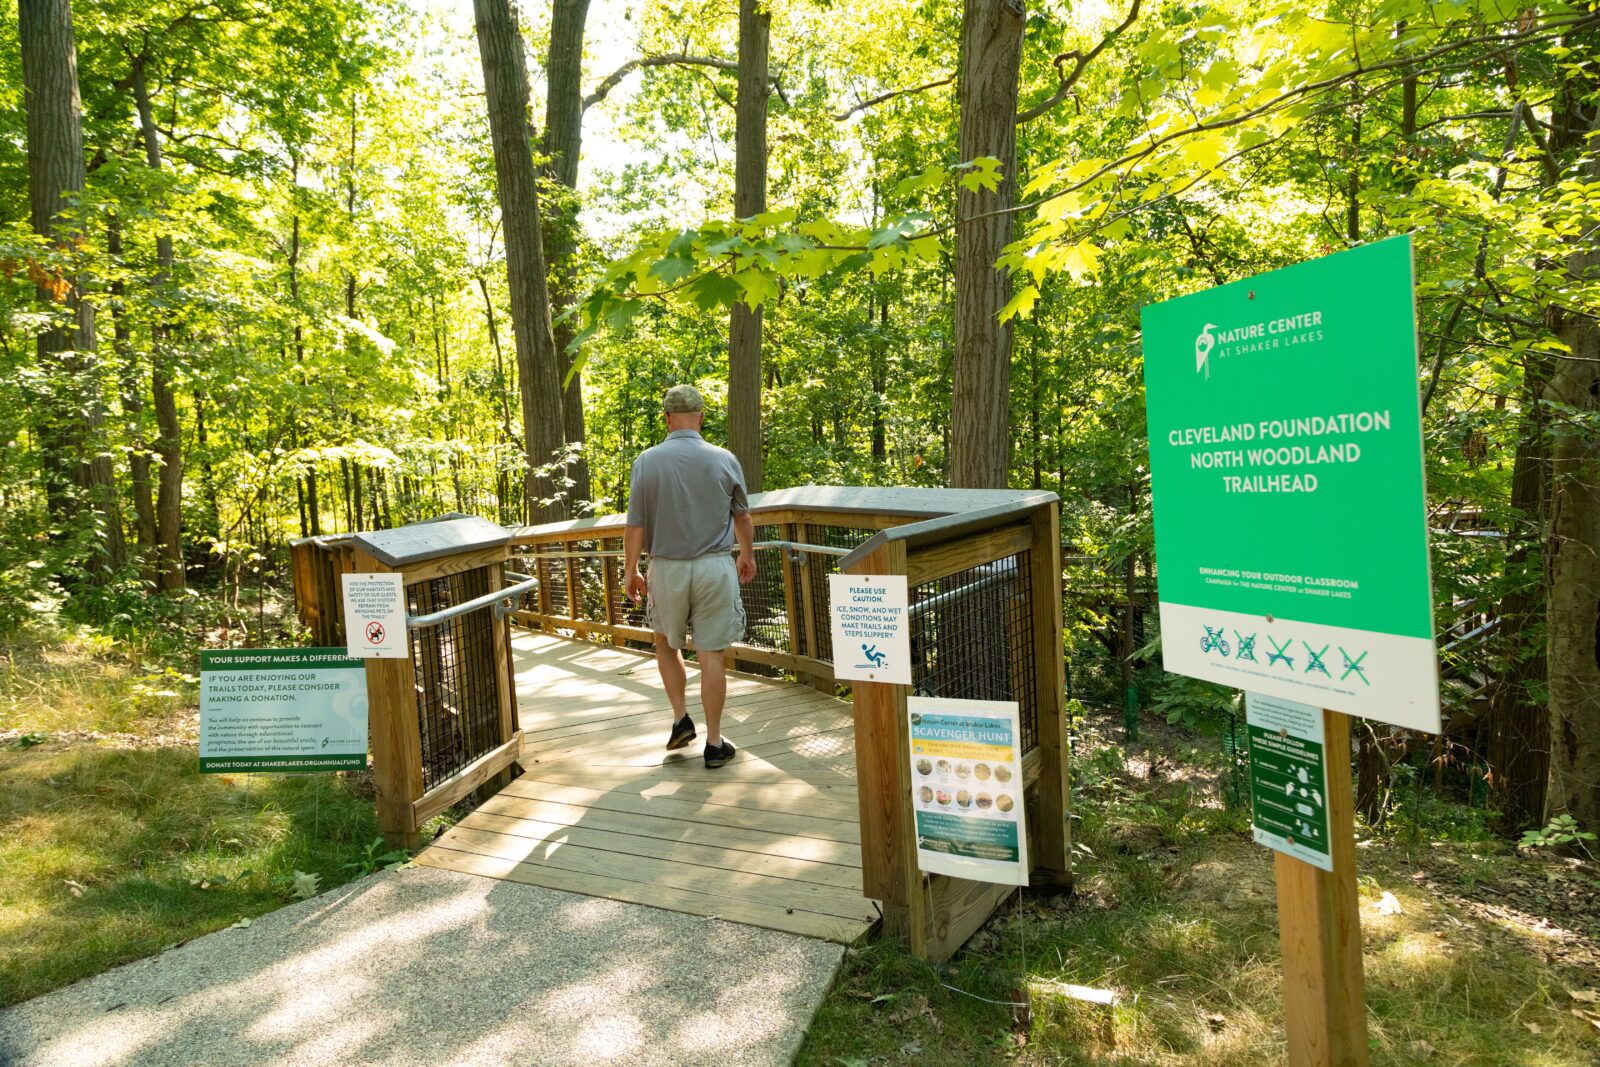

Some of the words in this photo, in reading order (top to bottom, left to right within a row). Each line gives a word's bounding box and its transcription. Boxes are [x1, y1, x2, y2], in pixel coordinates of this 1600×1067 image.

[1218, 323, 1265, 344] NATURE
[1268, 312, 1322, 334] CENTER
[1220, 348, 1230, 358] AT
[1235, 339, 1279, 356] SHAKER
[1285, 330, 1323, 346] LAKES
[1168, 423, 1255, 446] CLEVELAND
[1260, 410, 1390, 439] FOUNDATION
[1191, 450, 1243, 469] NORTH
[1248, 443, 1360, 466] WOODLAND
[1223, 474, 1318, 493] TRAILHEAD
[1200, 567, 1240, 578] ENHANCING
[1241, 571, 1261, 580] YOUR
[1263, 572, 1302, 584] OUTDOOR
[1304, 577, 1358, 589] CLASSROOM
[1274, 585, 1296, 593] CENTER
[1305, 588, 1329, 596] SHAKER
[914, 727, 976, 740] SCAVENGER
[979, 732, 1010, 741] HUNT
[1264, 732, 1282, 742] PLEASE
[1283, 737, 1304, 748] FOLLOW
